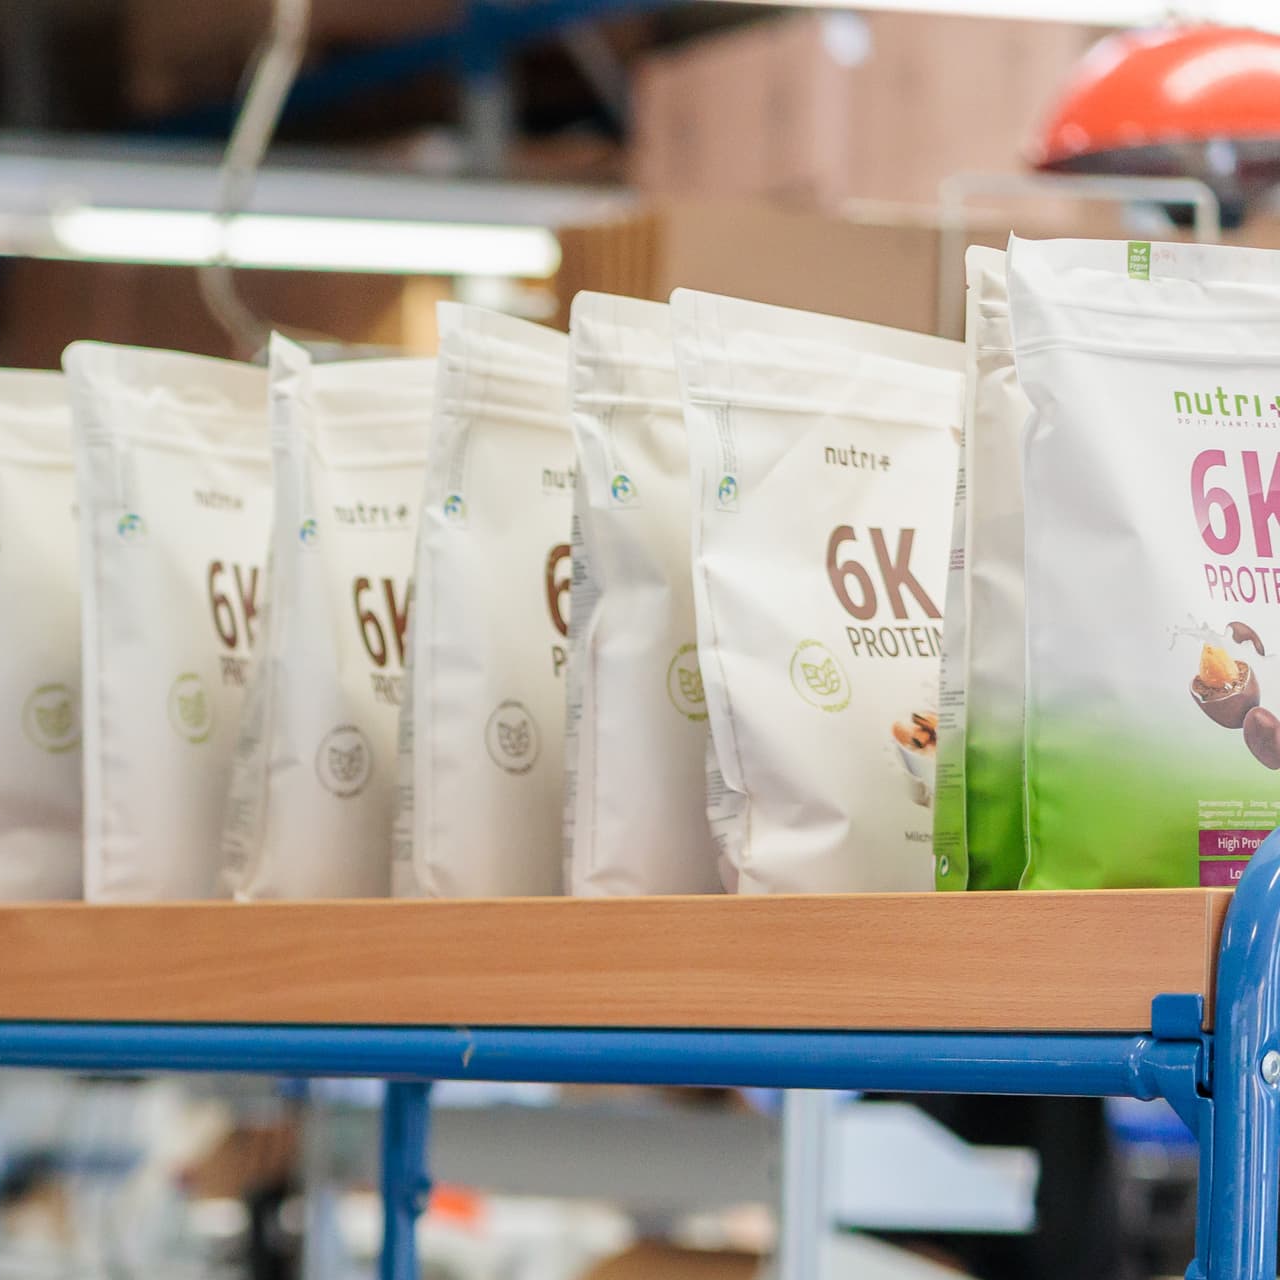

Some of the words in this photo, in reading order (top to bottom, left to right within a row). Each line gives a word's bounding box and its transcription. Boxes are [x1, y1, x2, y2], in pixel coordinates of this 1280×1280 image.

[1215, 420, 1280, 429] PLANT-BAS
[826, 524, 944, 621] 6K
[1217, 837, 1240, 852] High
